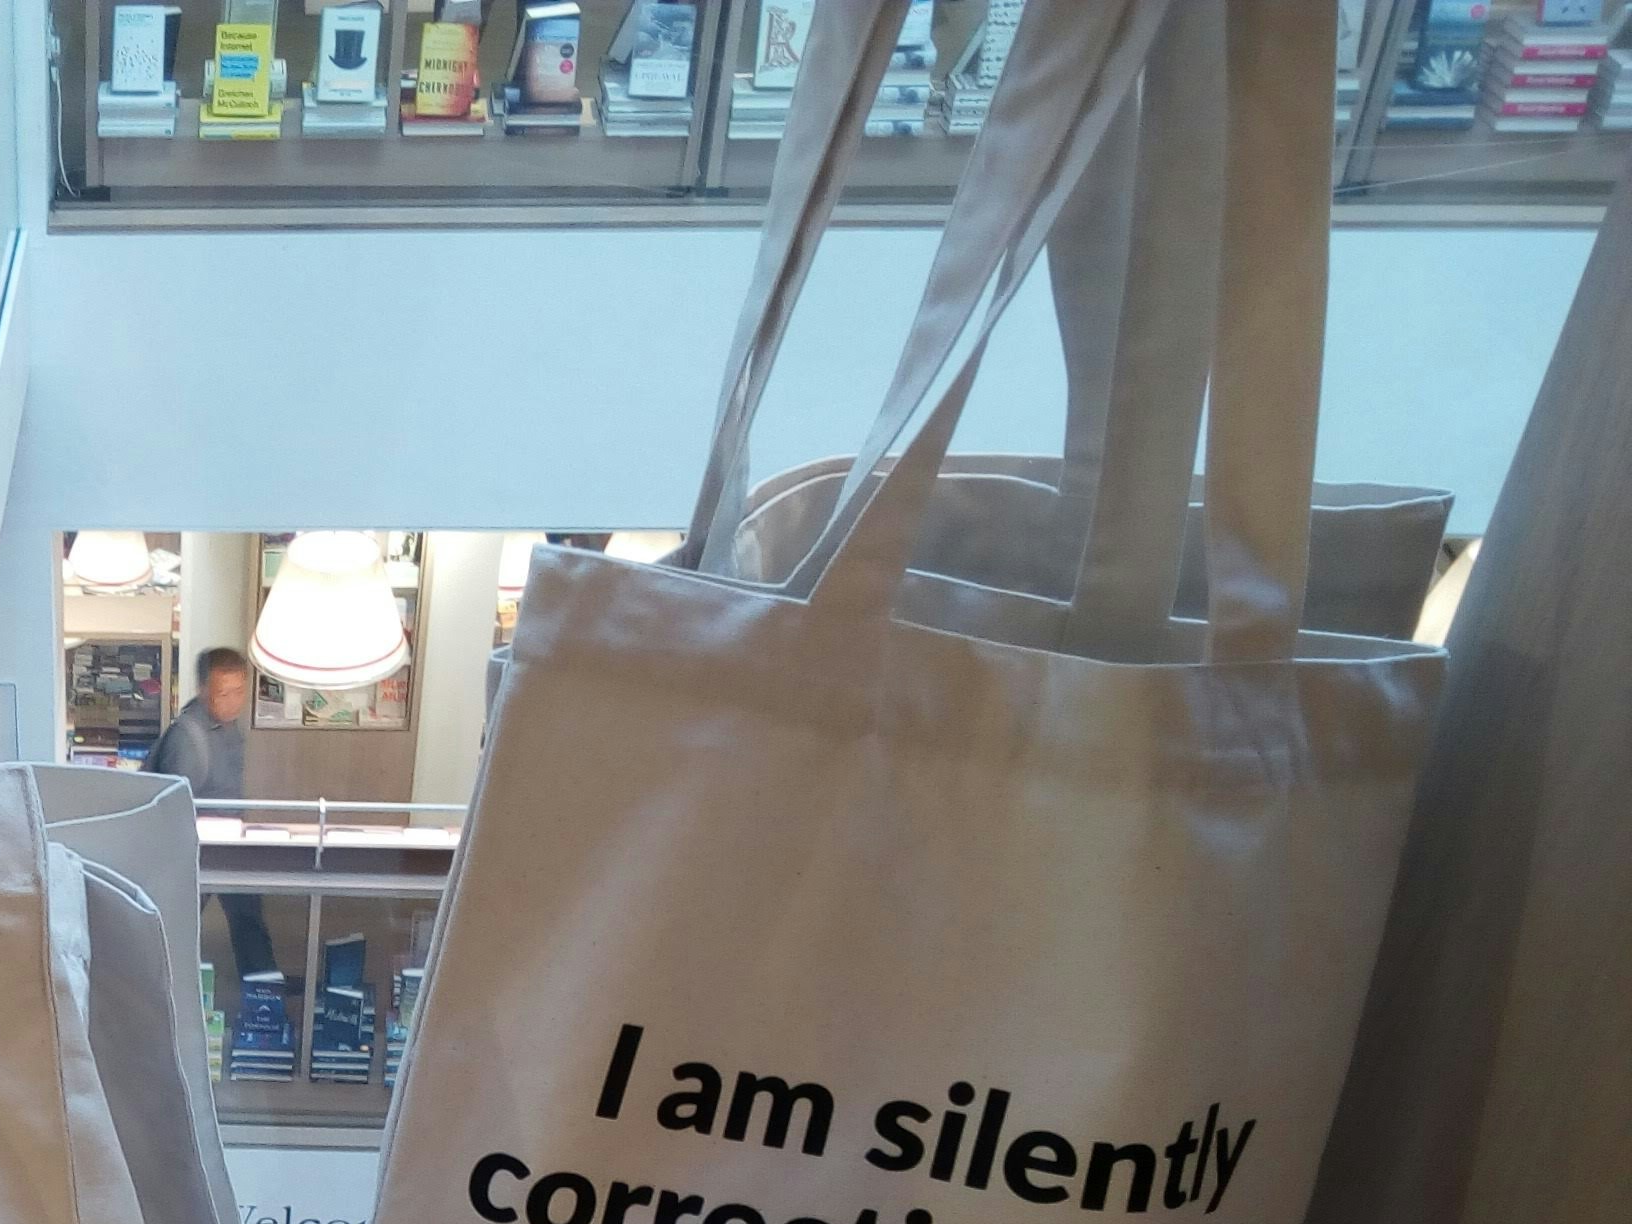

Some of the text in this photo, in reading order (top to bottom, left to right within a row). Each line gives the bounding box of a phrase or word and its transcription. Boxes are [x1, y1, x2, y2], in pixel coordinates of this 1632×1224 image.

[596, 1024, 1256, 1214] I am silently
